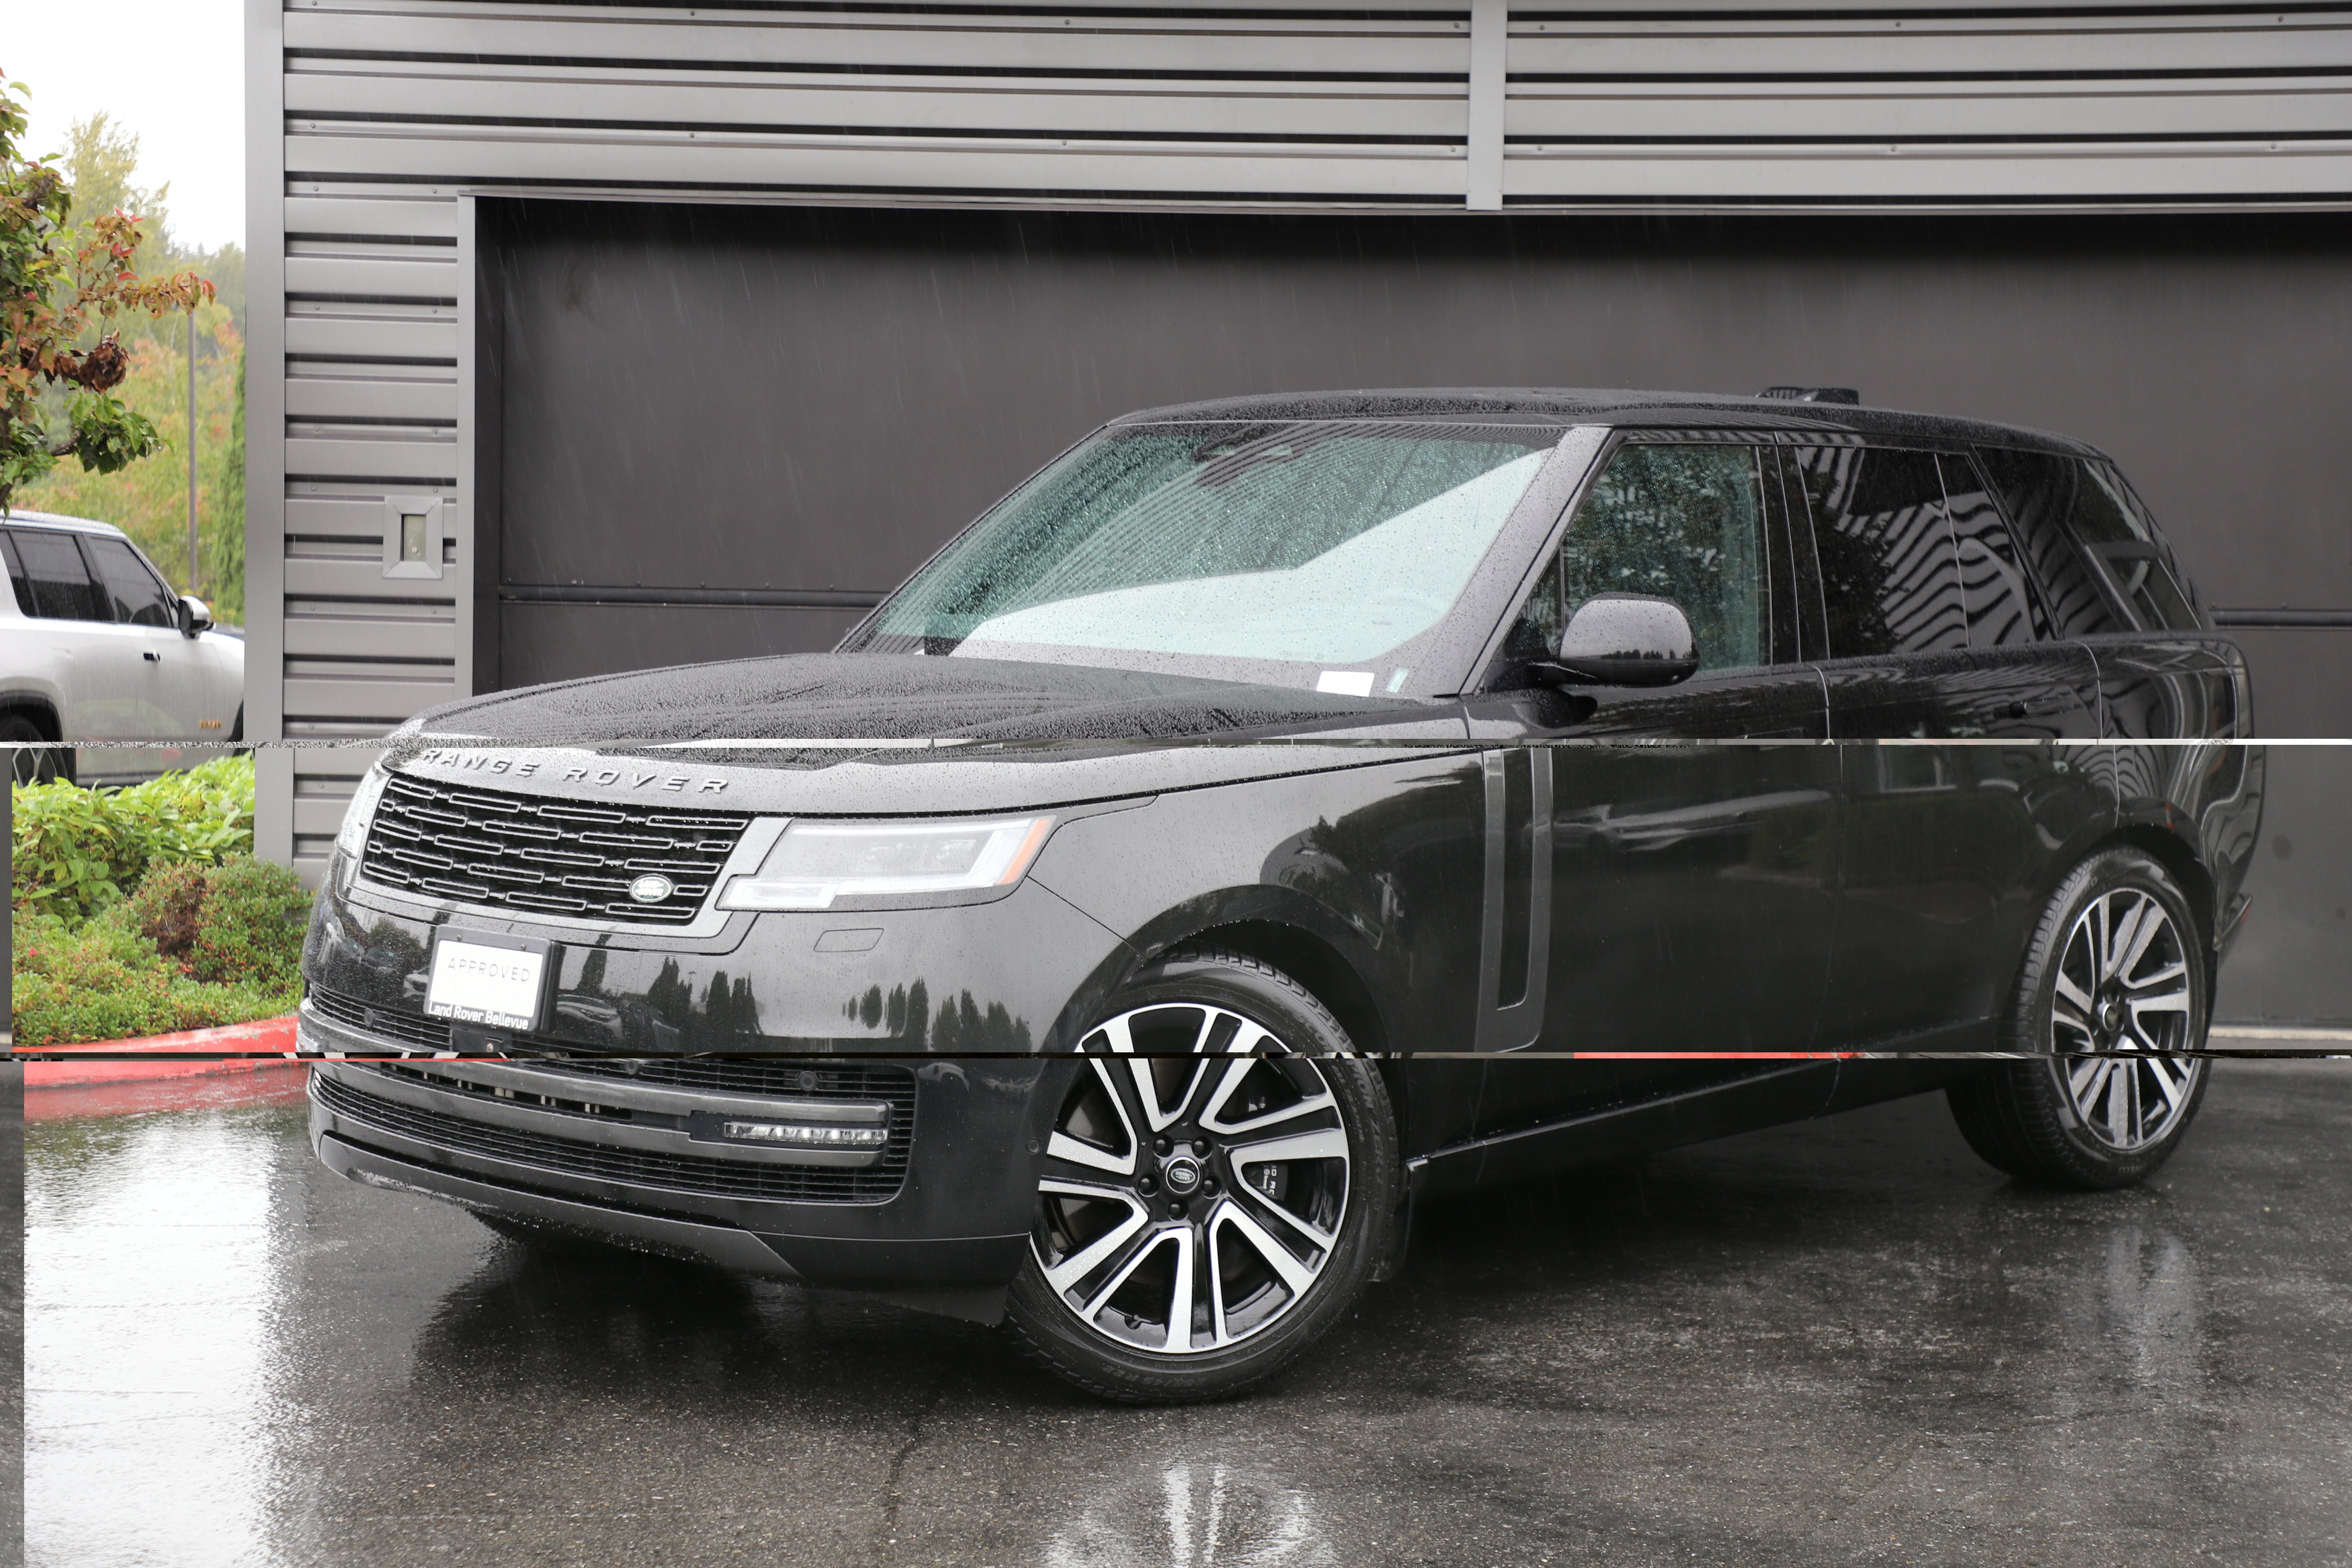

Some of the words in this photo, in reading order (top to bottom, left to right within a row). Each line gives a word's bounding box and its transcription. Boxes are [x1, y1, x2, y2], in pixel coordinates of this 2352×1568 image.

[422, 748, 540, 777] RANGE
[563, 766, 728, 793] ROVER
[447, 958, 530, 982] APPROVED
[428, 1002, 453, 1017] Land
[454, 1005, 484, 1022] Rover
[485, 1010, 529, 1030] Bellevue
